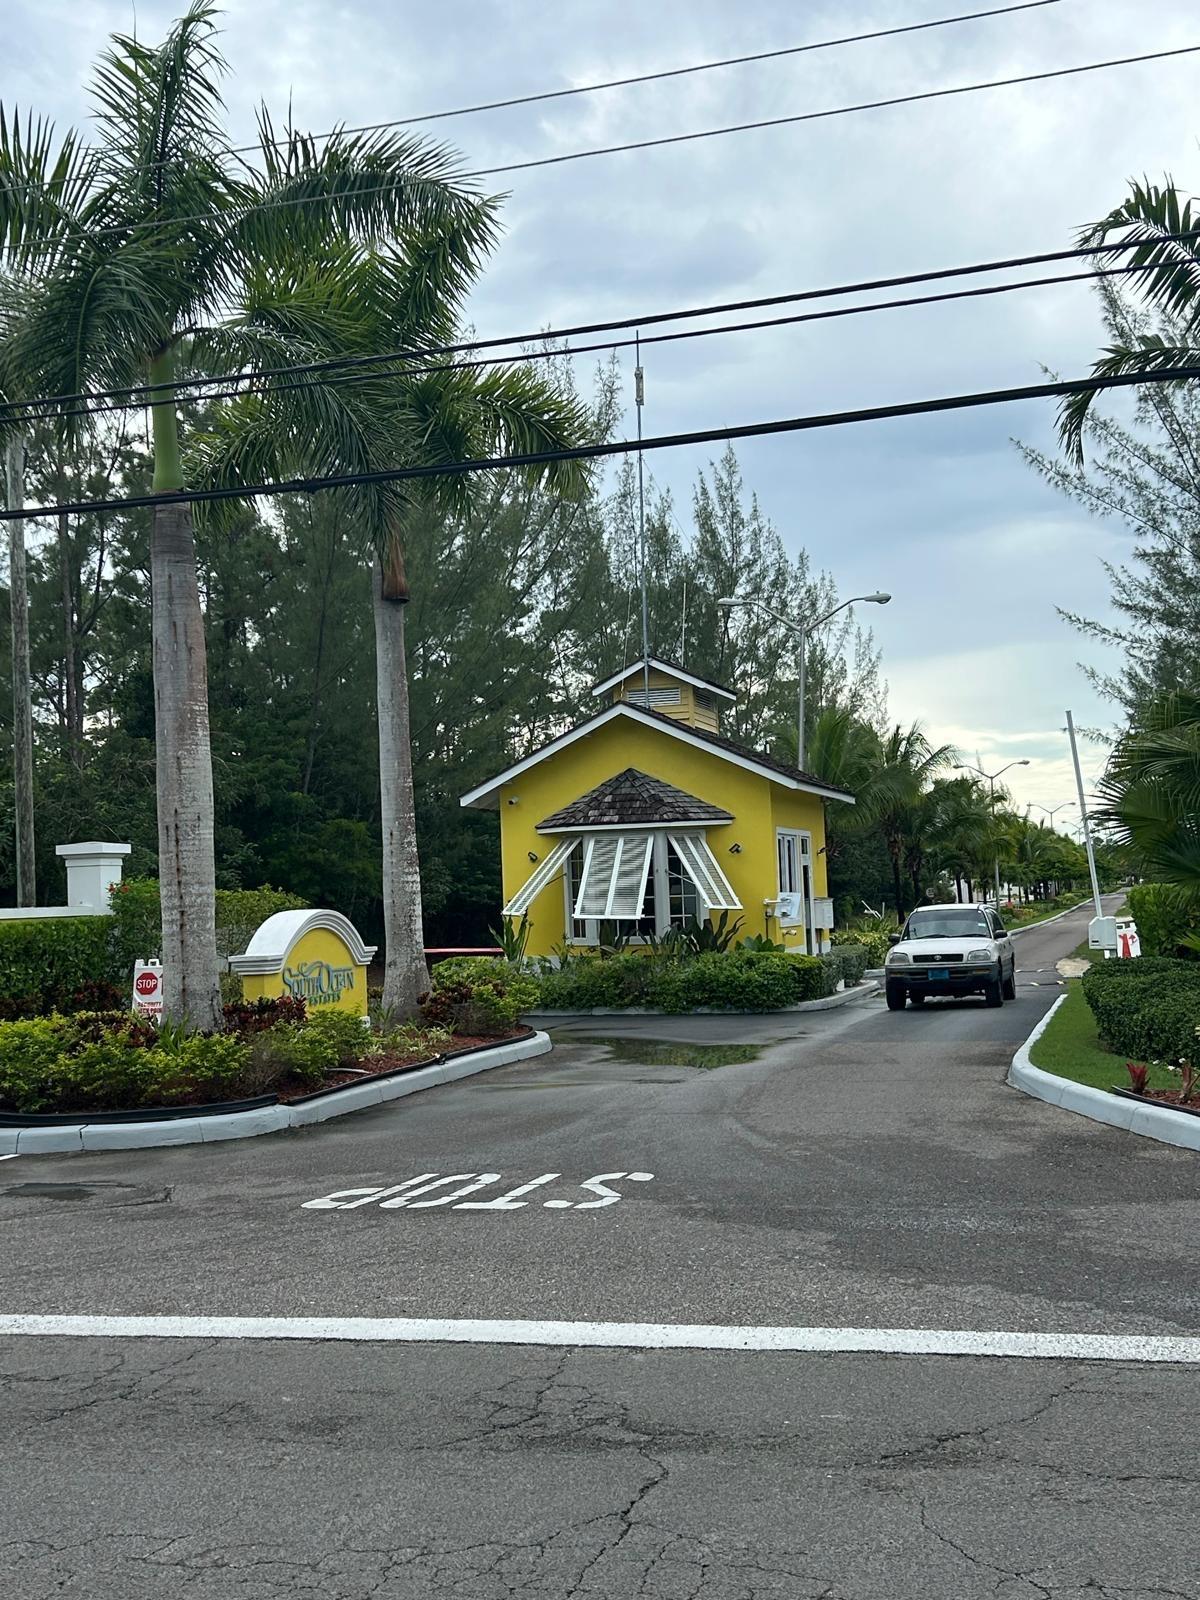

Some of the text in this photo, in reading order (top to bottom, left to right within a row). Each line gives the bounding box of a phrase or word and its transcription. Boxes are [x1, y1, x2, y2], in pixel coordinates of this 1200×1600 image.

[137, 979, 158, 989] STOP
[309, 991, 341, 1006] ESTATES
[300, 1172, 655, 1210] STOP
